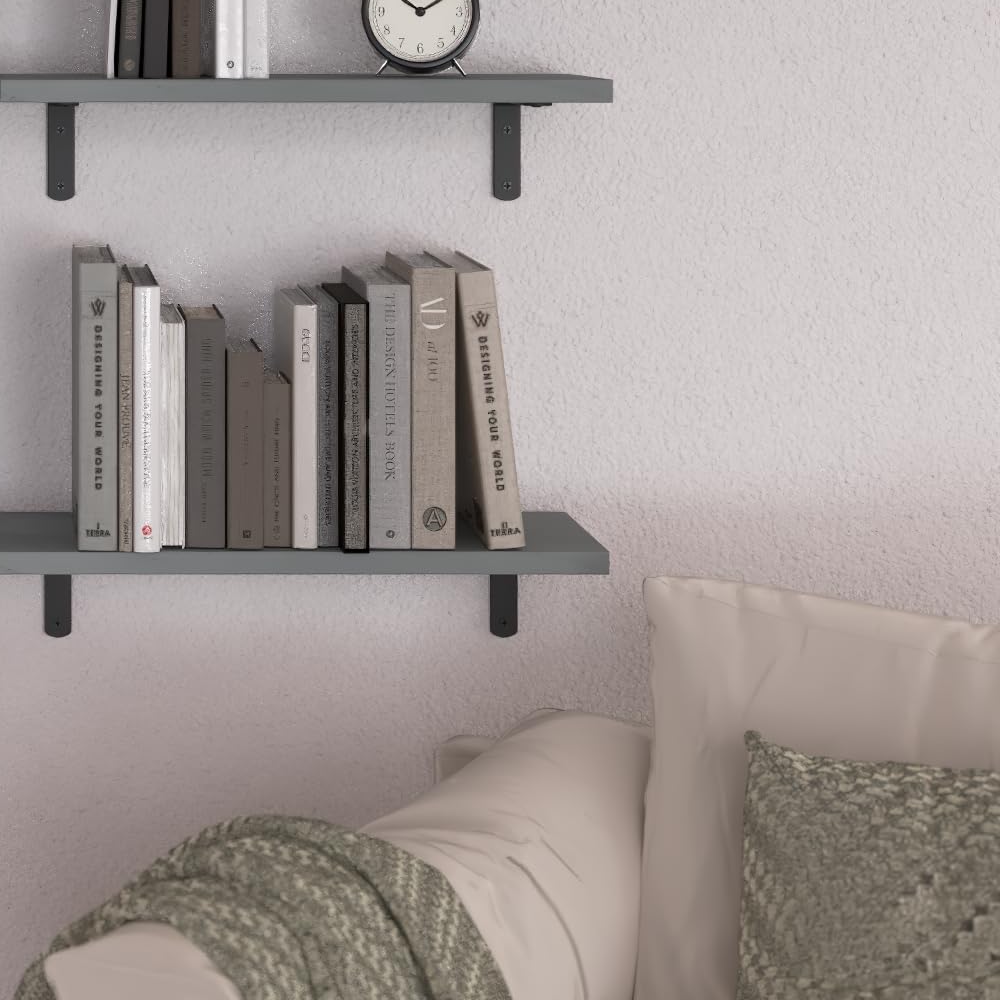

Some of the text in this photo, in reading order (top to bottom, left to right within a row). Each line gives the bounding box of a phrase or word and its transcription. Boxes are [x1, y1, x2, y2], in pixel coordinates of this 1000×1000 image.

[378, 6, 385, 17] 9
[455, 6, 463, 17] 3
[383, 24, 391, 34] 8
[450, 25, 456, 36] 4
[398, 38, 405, 48] 7
[416, 43, 424, 53] 6
[437, 38, 444, 48] 5
[385, 326, 396, 377] DESIGN
[120, 374, 131, 400] JEAN
[94, 325, 103, 490] DESIGNING YOUR WORLD
[385, 382, 396, 437] HOTELS
[477, 335, 505, 492] DESIGNING YOUR WORLD
[385, 441, 396, 480] BOOK
[86, 529, 111, 537] TERRA
[490, 527, 521, 537] TERRA
